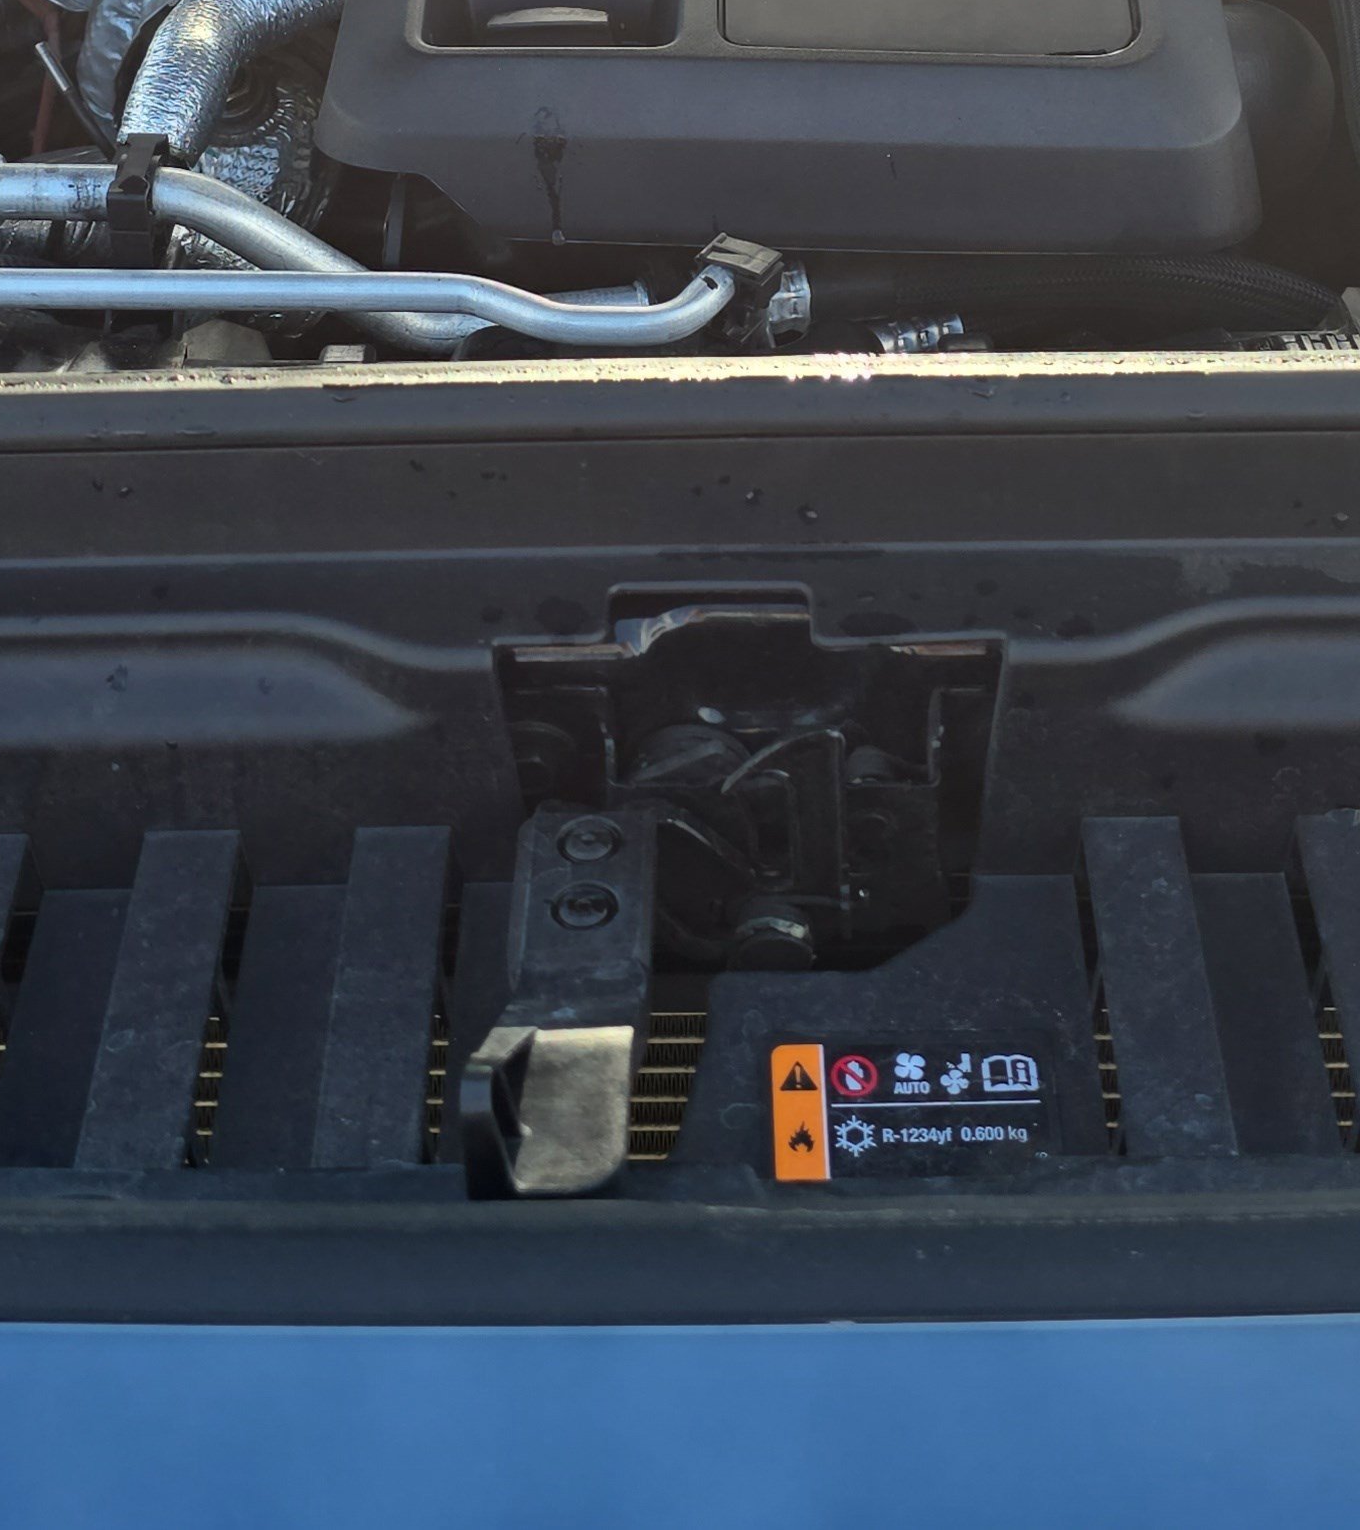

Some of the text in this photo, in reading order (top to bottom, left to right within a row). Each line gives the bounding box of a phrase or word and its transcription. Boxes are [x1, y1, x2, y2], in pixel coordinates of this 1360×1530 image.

[894, 1080, 931, 1095] AUTO
[882, 1125, 1029, 1146] R-1234yf 0.600 kg
